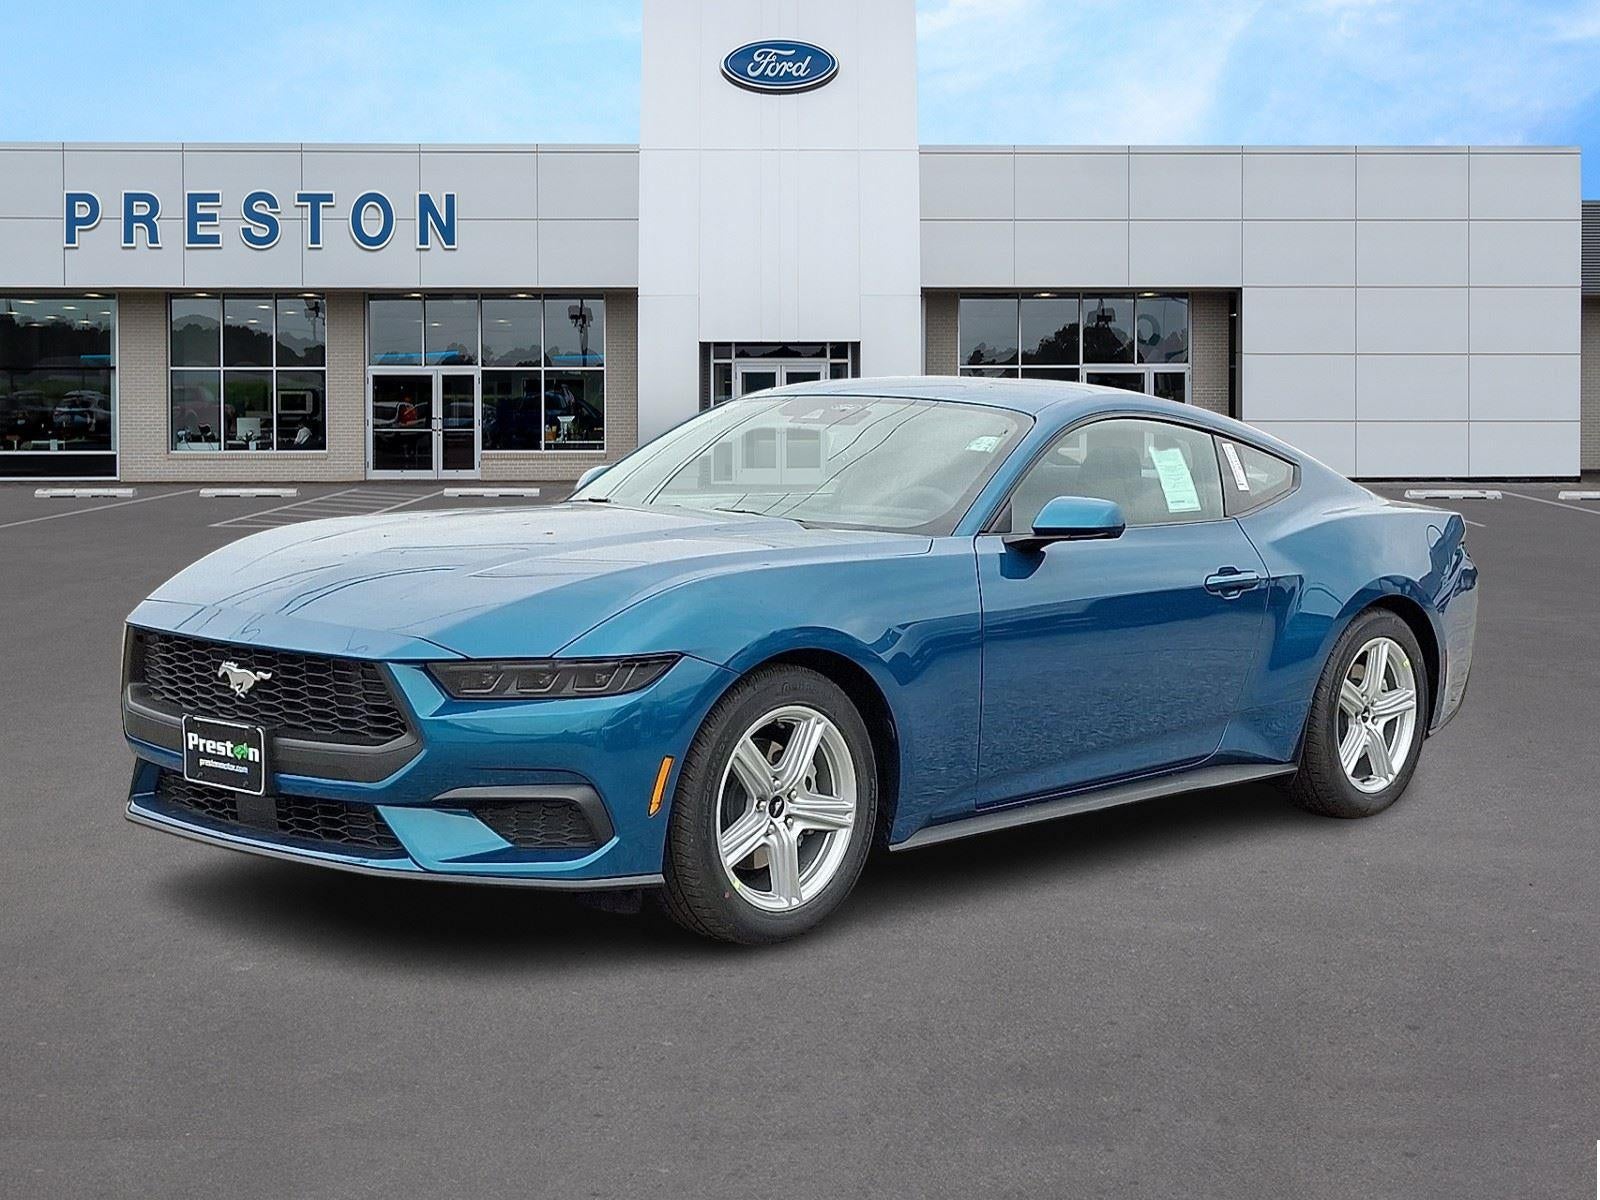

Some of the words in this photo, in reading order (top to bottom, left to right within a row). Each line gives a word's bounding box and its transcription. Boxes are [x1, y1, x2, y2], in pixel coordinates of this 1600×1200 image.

[747, 48, 812, 77] Ford
[64, 190, 458, 250] PRESTON
[187, 732, 260, 763] Preston
